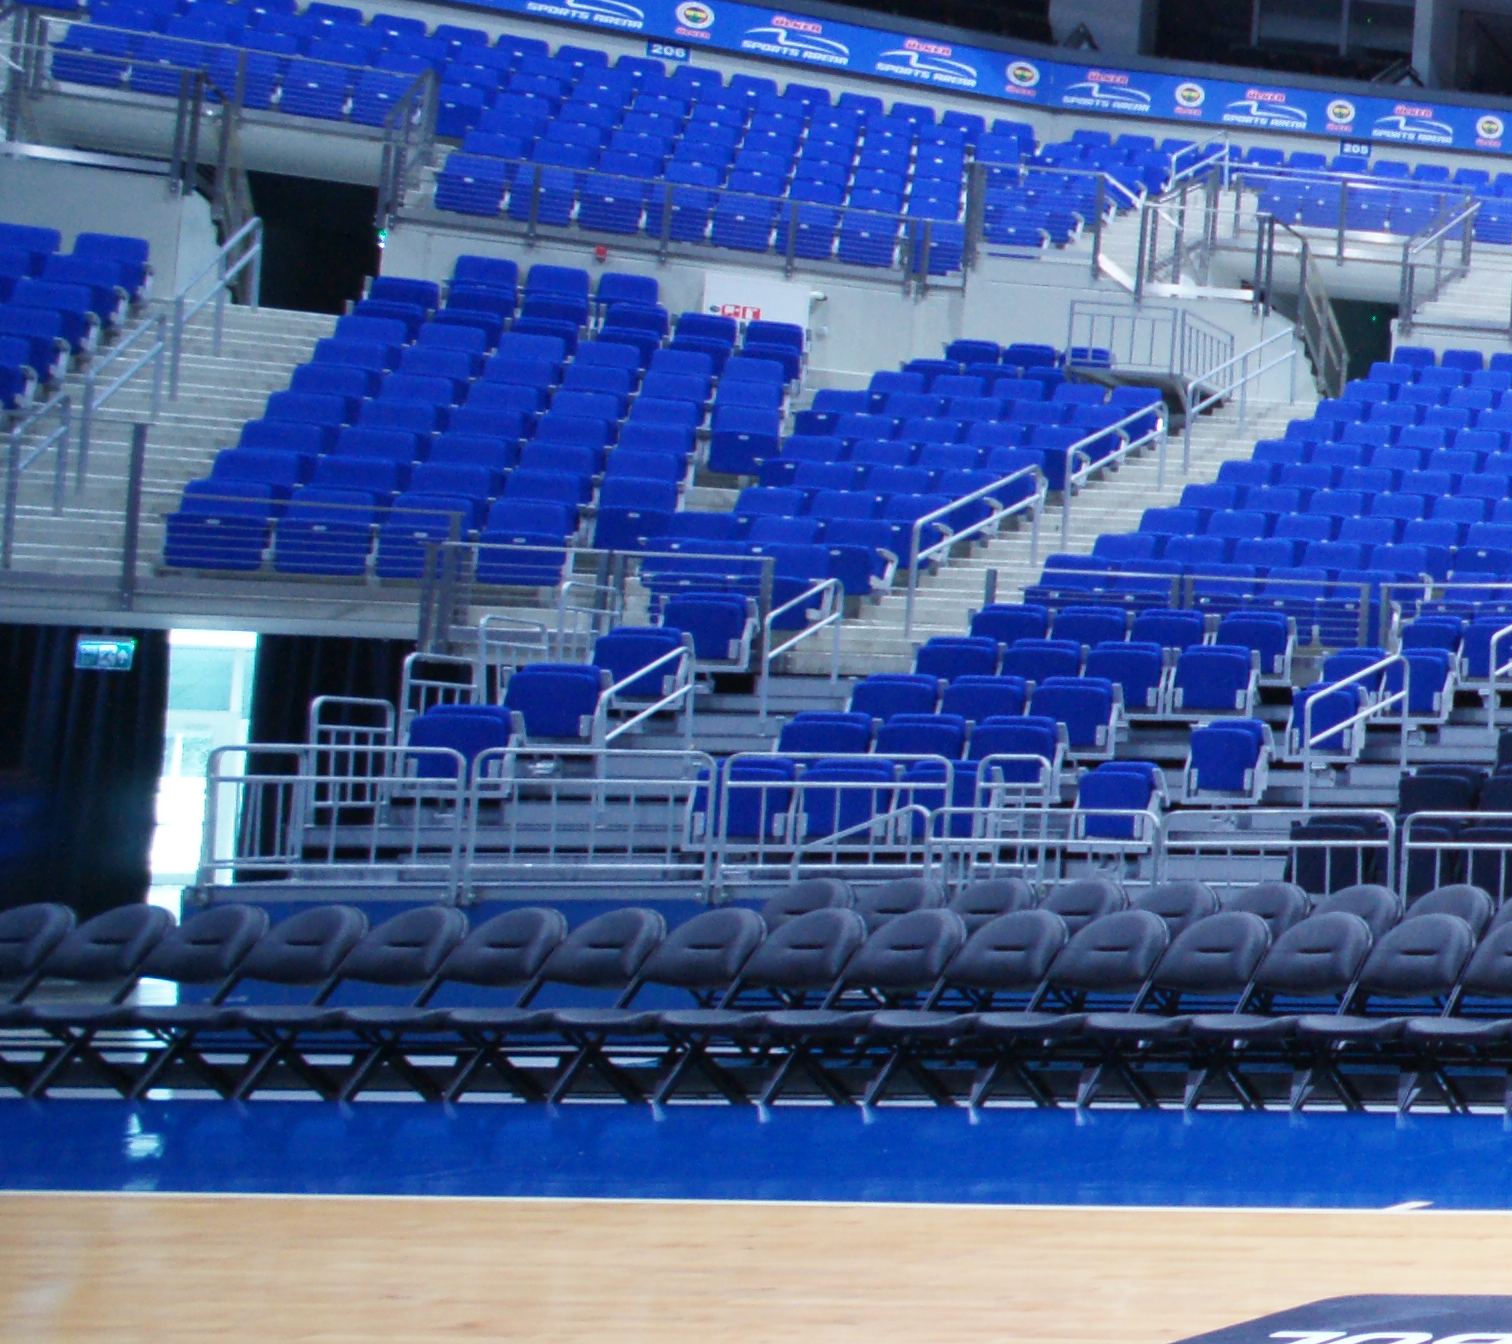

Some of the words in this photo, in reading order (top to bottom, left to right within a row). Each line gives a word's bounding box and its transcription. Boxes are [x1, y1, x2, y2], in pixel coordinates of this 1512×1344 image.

[526, 2, 588, 20] SPORTS
[651, 43, 686, 58] 206
[742, 40, 798, 56] SPORTS
[876, 62, 928, 78] SPORTS
[1343, 143, 1369, 155] 205
